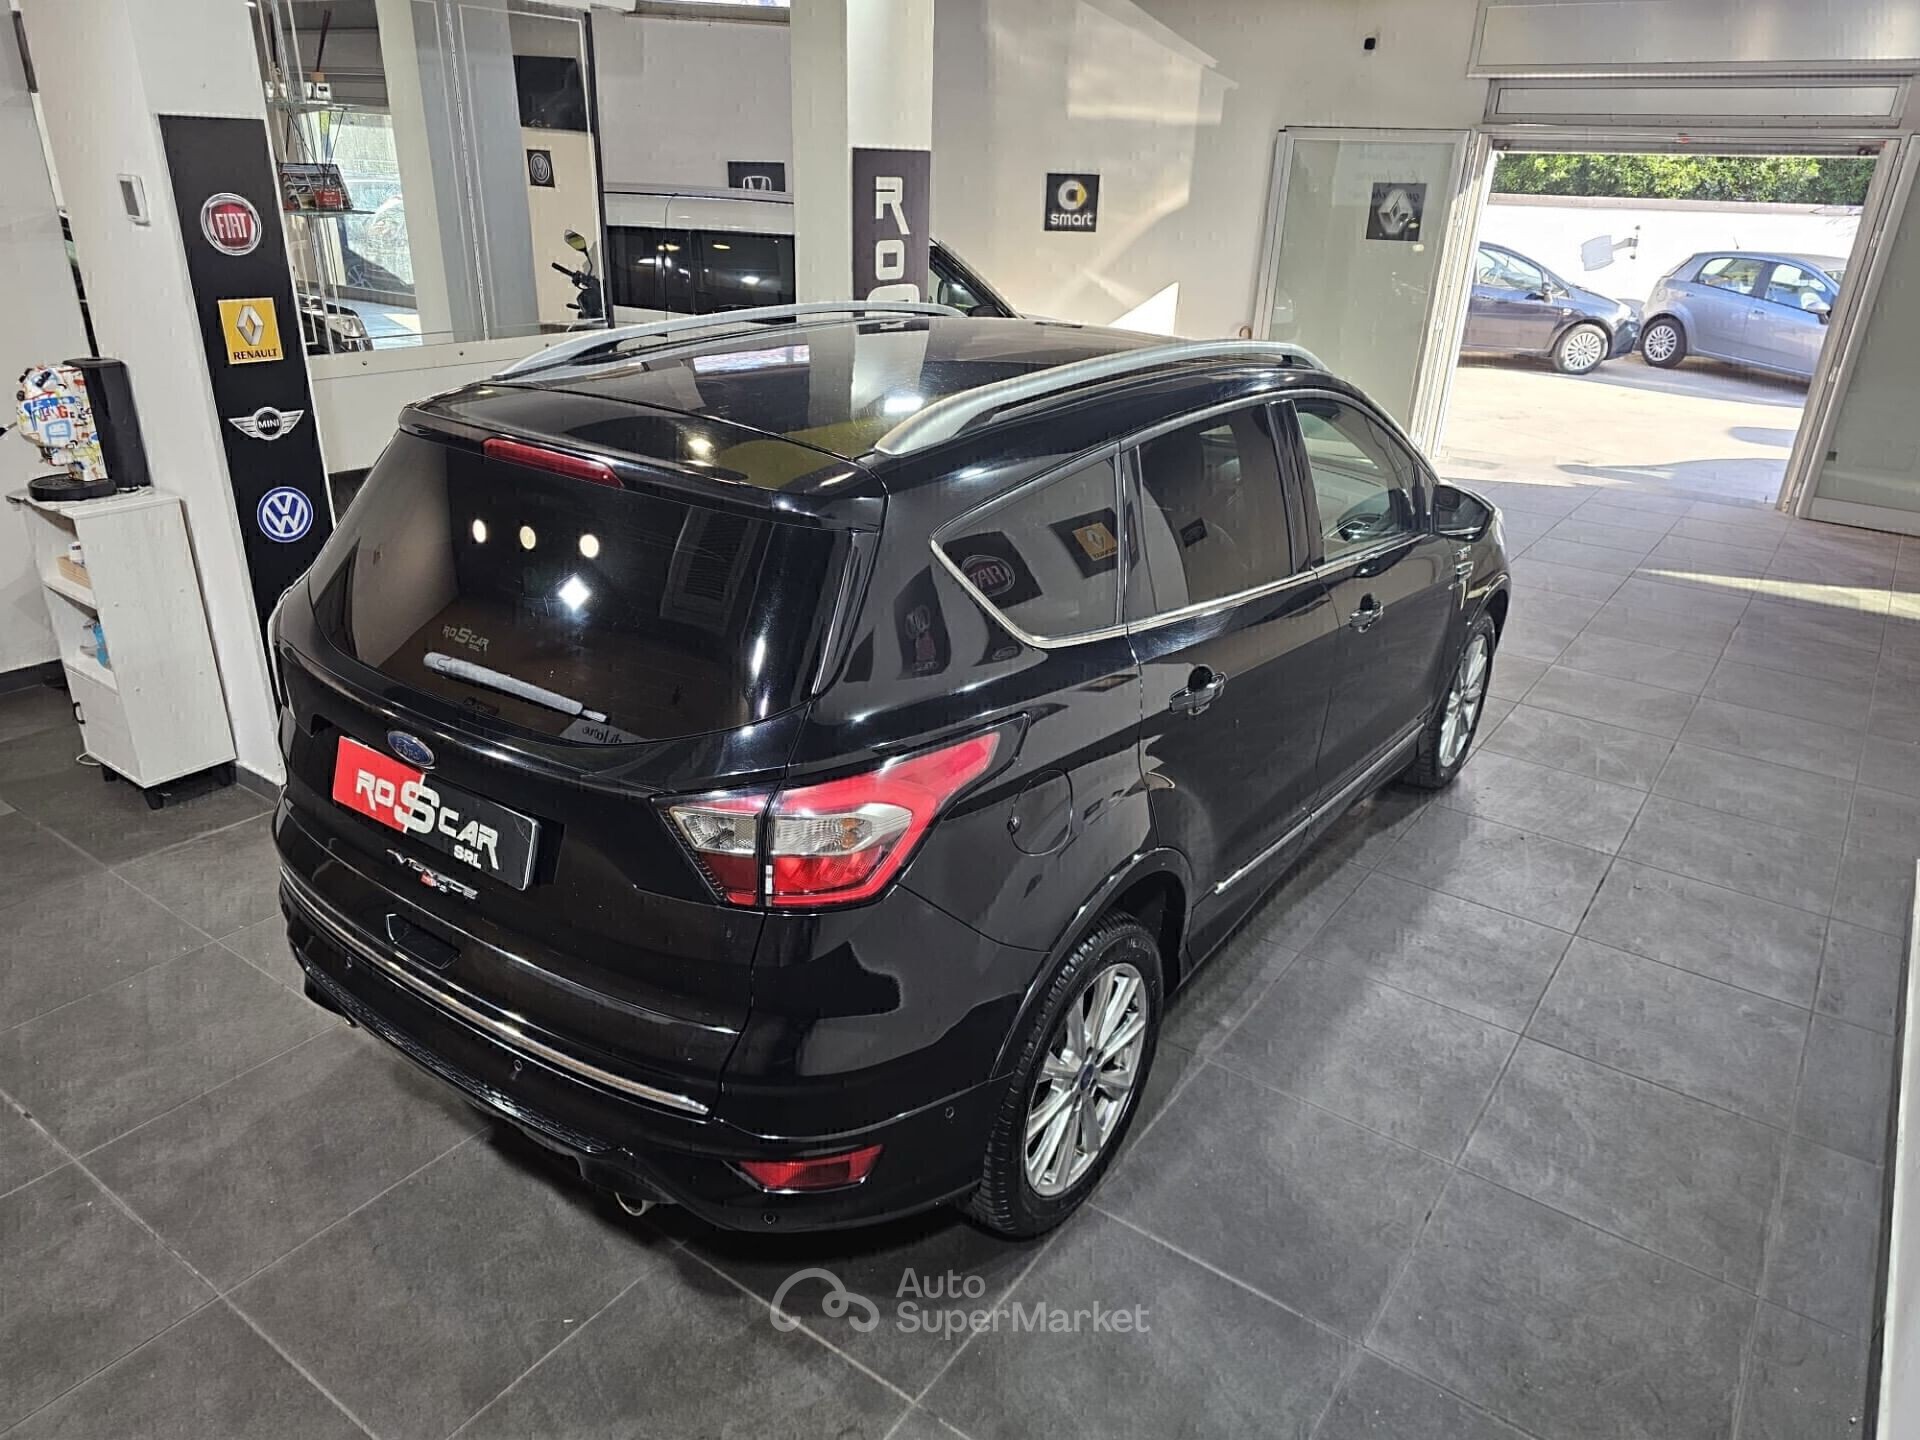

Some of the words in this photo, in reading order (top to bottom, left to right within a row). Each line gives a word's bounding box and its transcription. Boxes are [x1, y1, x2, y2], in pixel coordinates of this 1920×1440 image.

[215, 212, 248, 239] FIAT
[1050, 212, 1093, 226] smart
[233, 348, 278, 361] RENAULT
[257, 418, 280, 429] MINI
[453, 844, 482, 869] SRL
